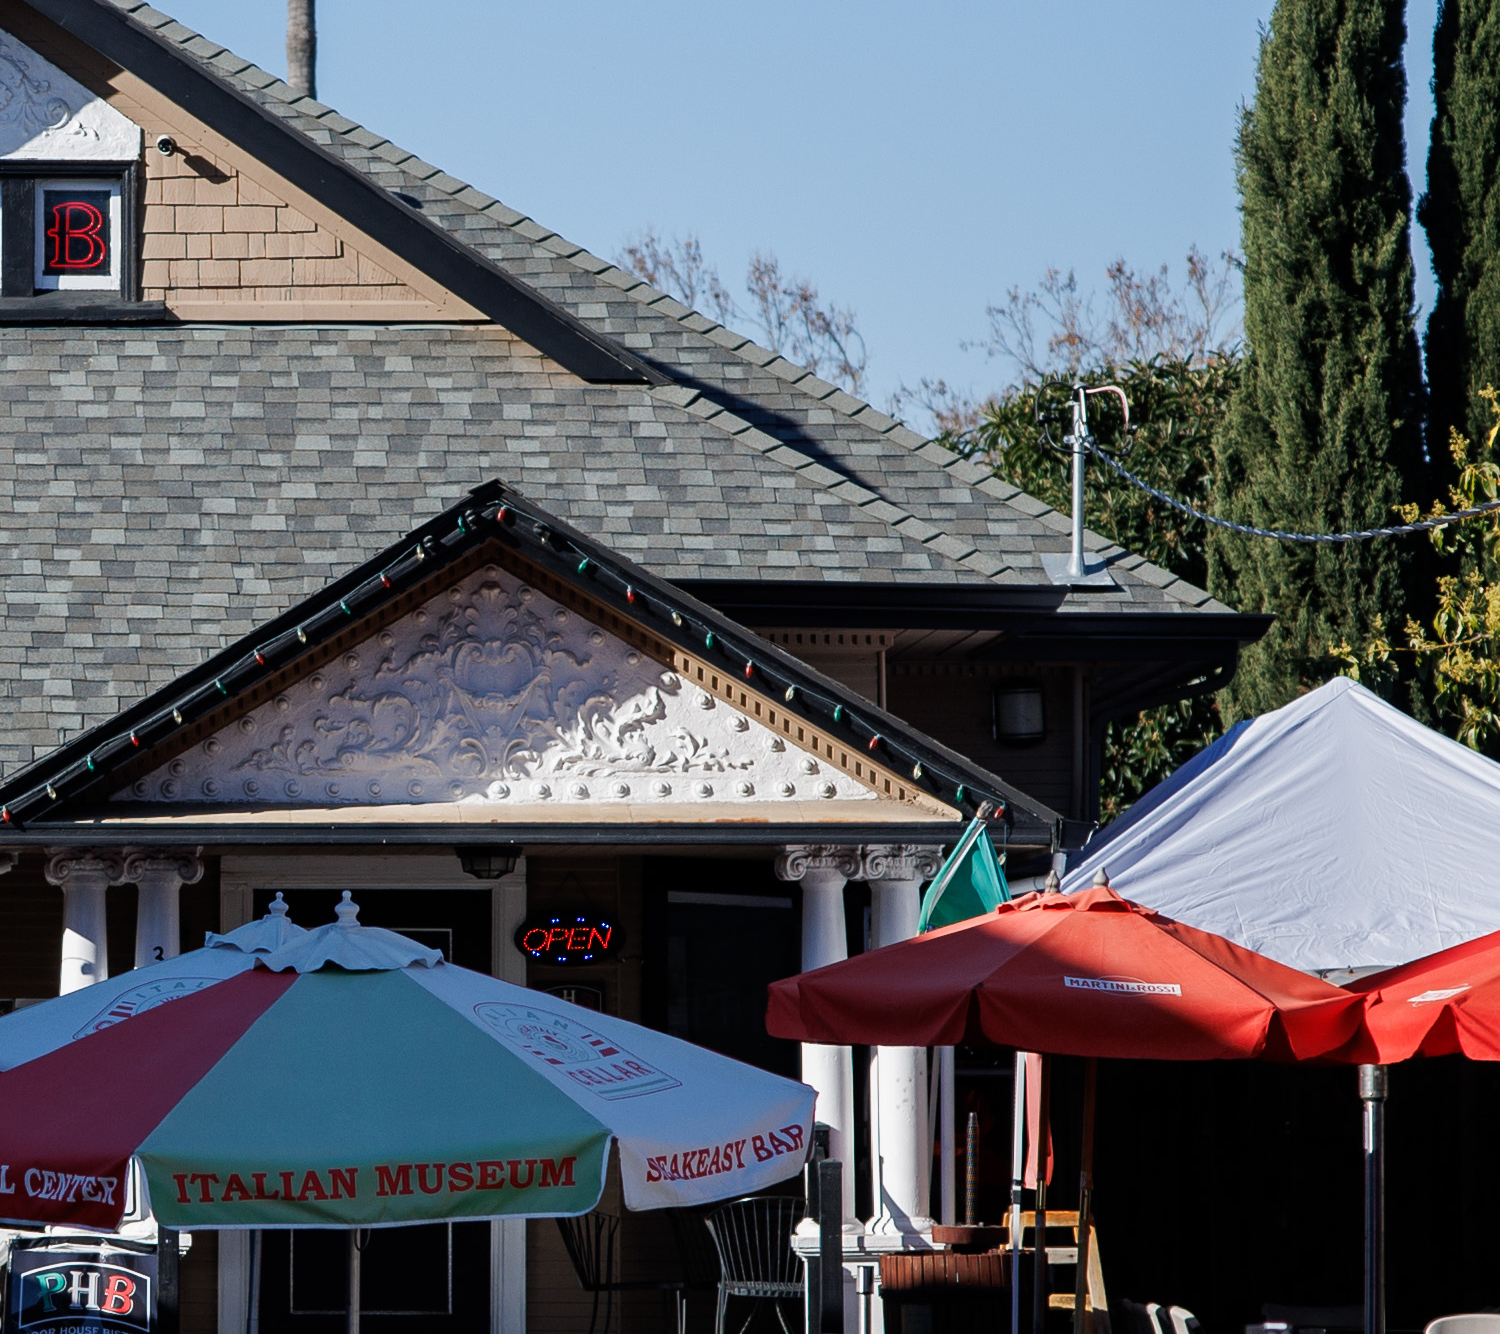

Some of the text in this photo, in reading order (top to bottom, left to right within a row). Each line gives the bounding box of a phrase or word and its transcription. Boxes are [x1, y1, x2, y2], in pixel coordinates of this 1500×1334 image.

[523, 927, 612, 951] OPEN
[752, 1124, 804, 1162] BAR
[24, 1168, 117, 1205] CENTER
[172, 1157, 577, 1204] ITALIAN MUSEUM
[36, 1270, 136, 1315] PHB
